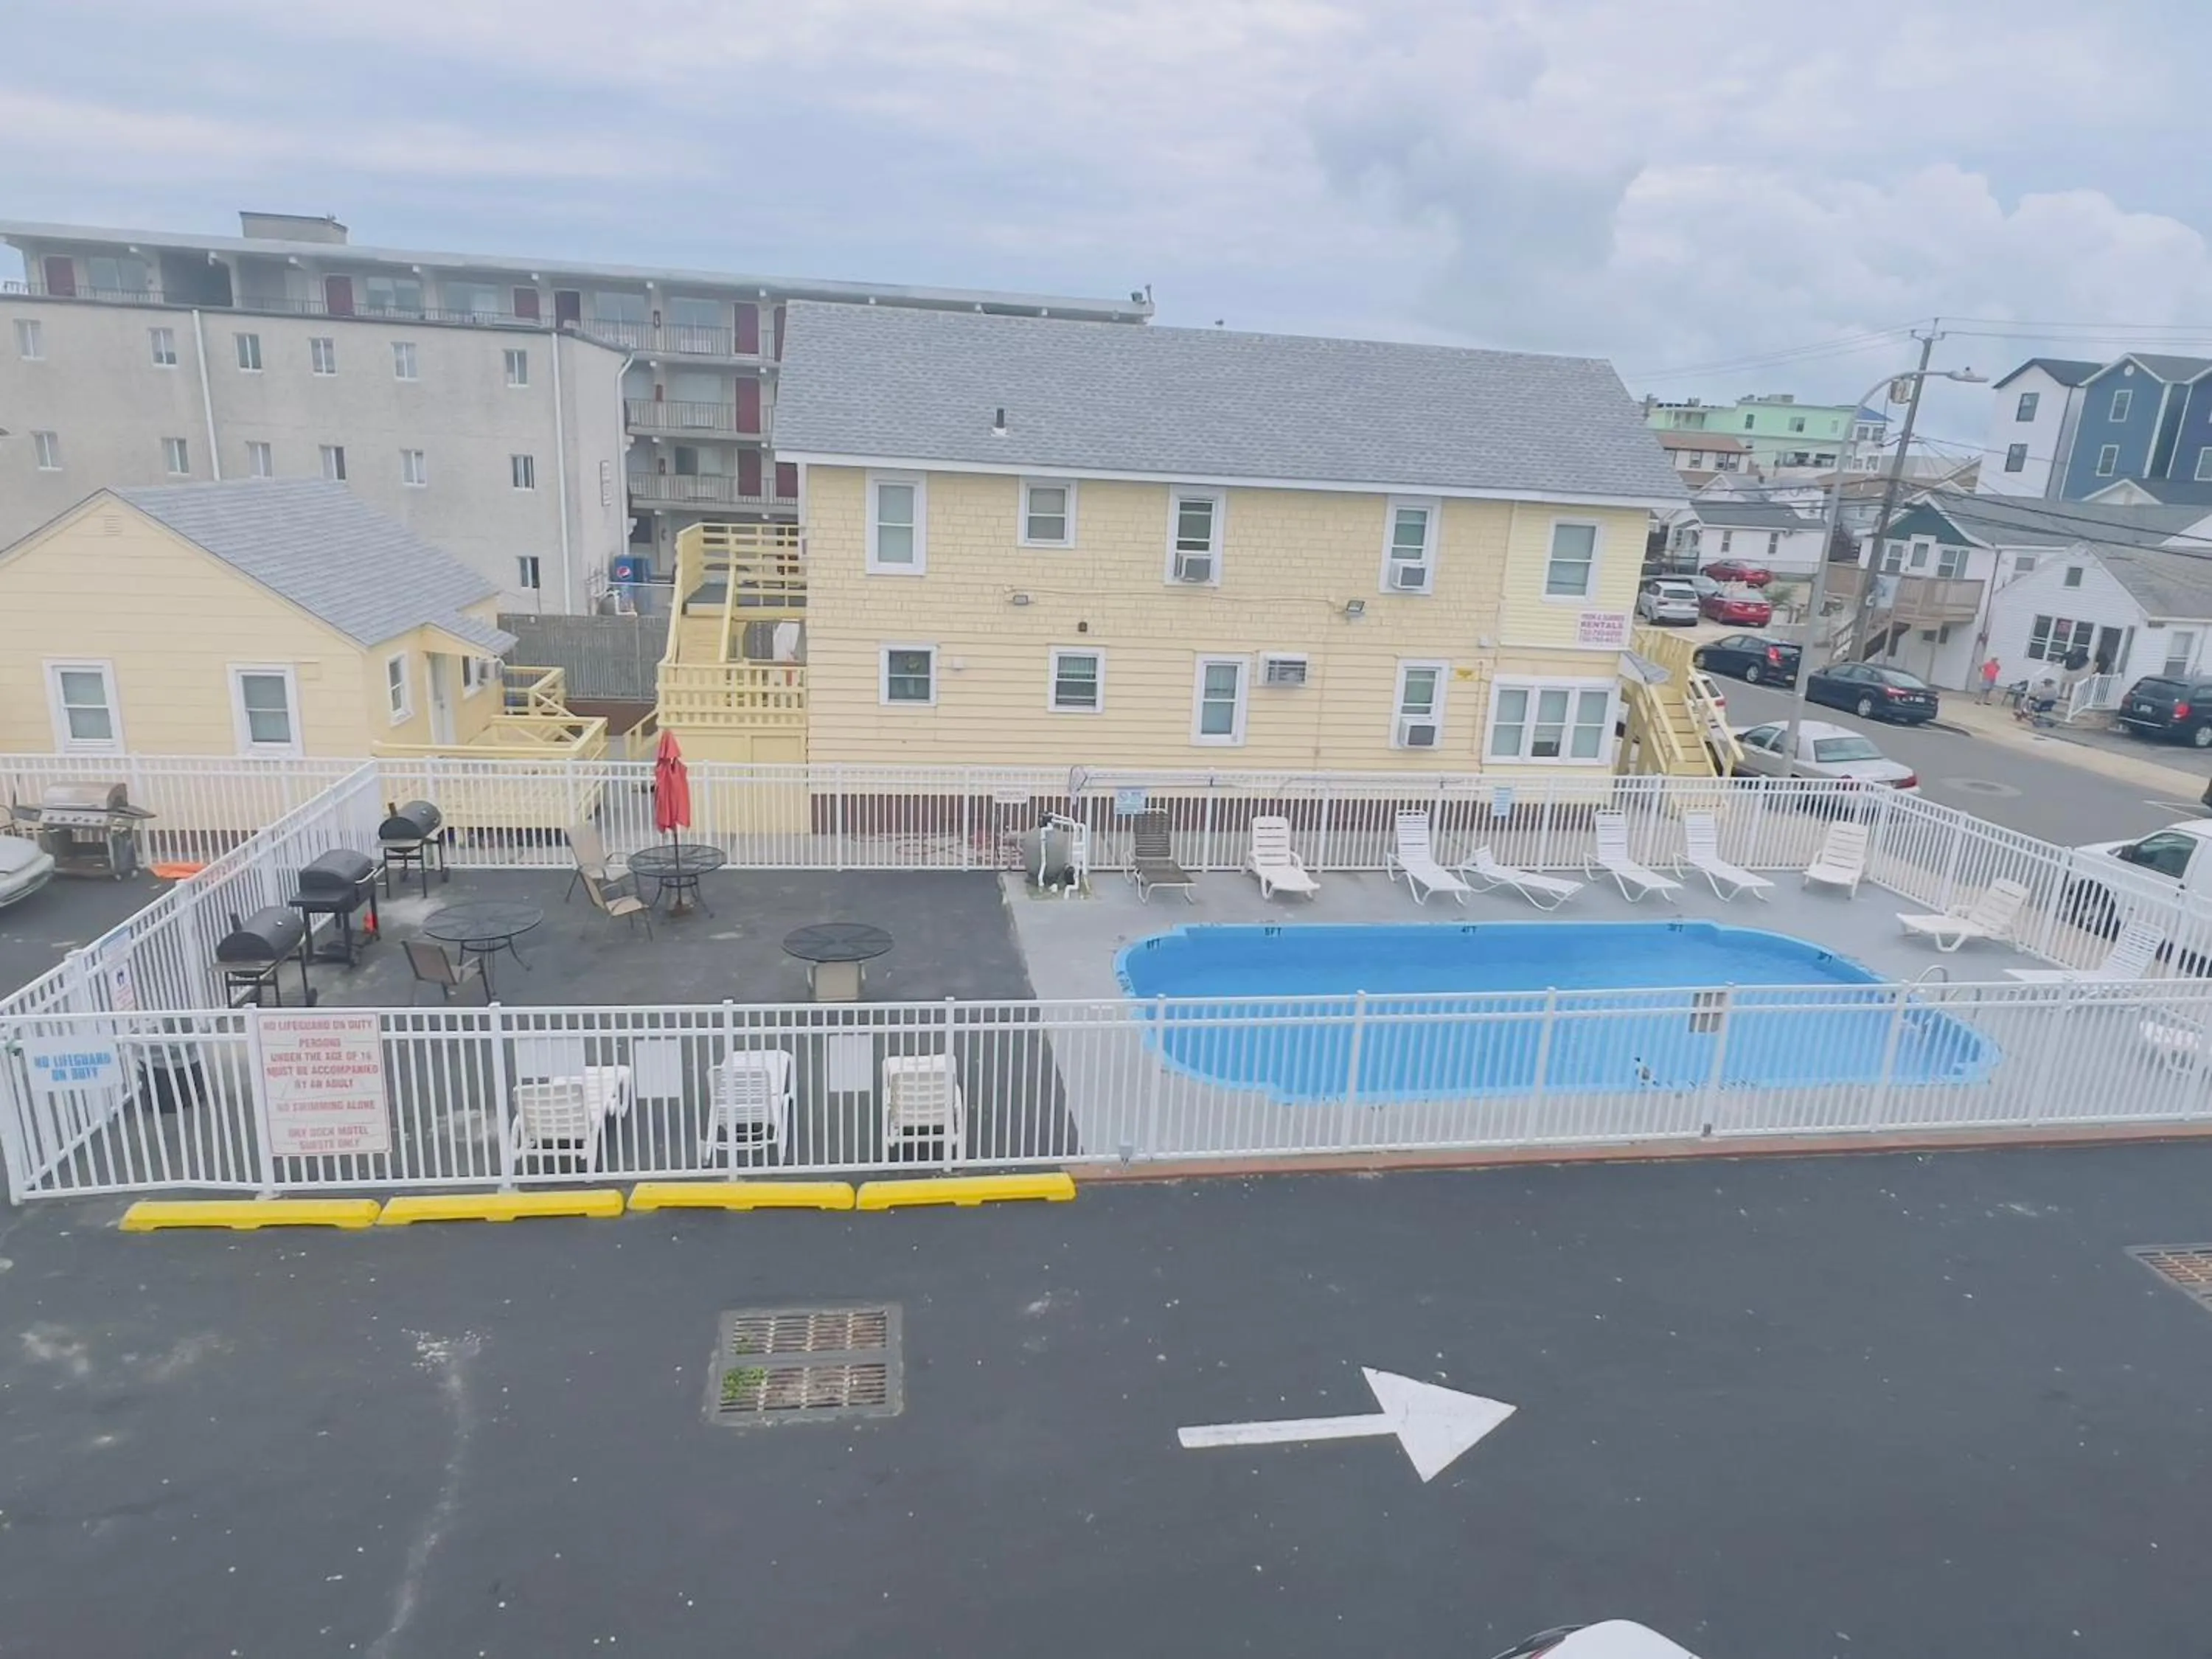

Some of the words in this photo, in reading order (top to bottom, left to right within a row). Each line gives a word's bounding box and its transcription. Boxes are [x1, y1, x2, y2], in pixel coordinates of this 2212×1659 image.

[1581, 622, 1624, 630] RENTALS
[264, 1020, 276, 1030] NO
[278, 1020, 330, 1030] LIFEGUARD
[333, 1020, 346, 1029] ON
[347, 1019, 372, 1029] DUTY
[299, 1037, 341, 1048] PERSONS
[34, 1055, 49, 1068] NO
[53, 1052, 111, 1067] LIFEGUARD
[271, 1052, 302, 1062] UNDER
[305, 1051, 321, 1061] THE
[325, 1051, 343, 1061] AGE
[346, 1051, 357, 1060] OF
[52, 1068, 67, 1082] ON
[71, 1067, 98, 1080] DUTY
[266, 1066, 293, 1077] MUST
[296, 1065, 308, 1075] BE
[311, 1064, 379, 1075] ACCOMPANIED
[295, 1079, 307, 1089] BY
[310, 1079, 323, 1088] AN
[326, 1079, 353, 1088] ADULT
[347, 1099, 376, 1110] ALONE
[337, 1125, 369, 1135] MOTEL
